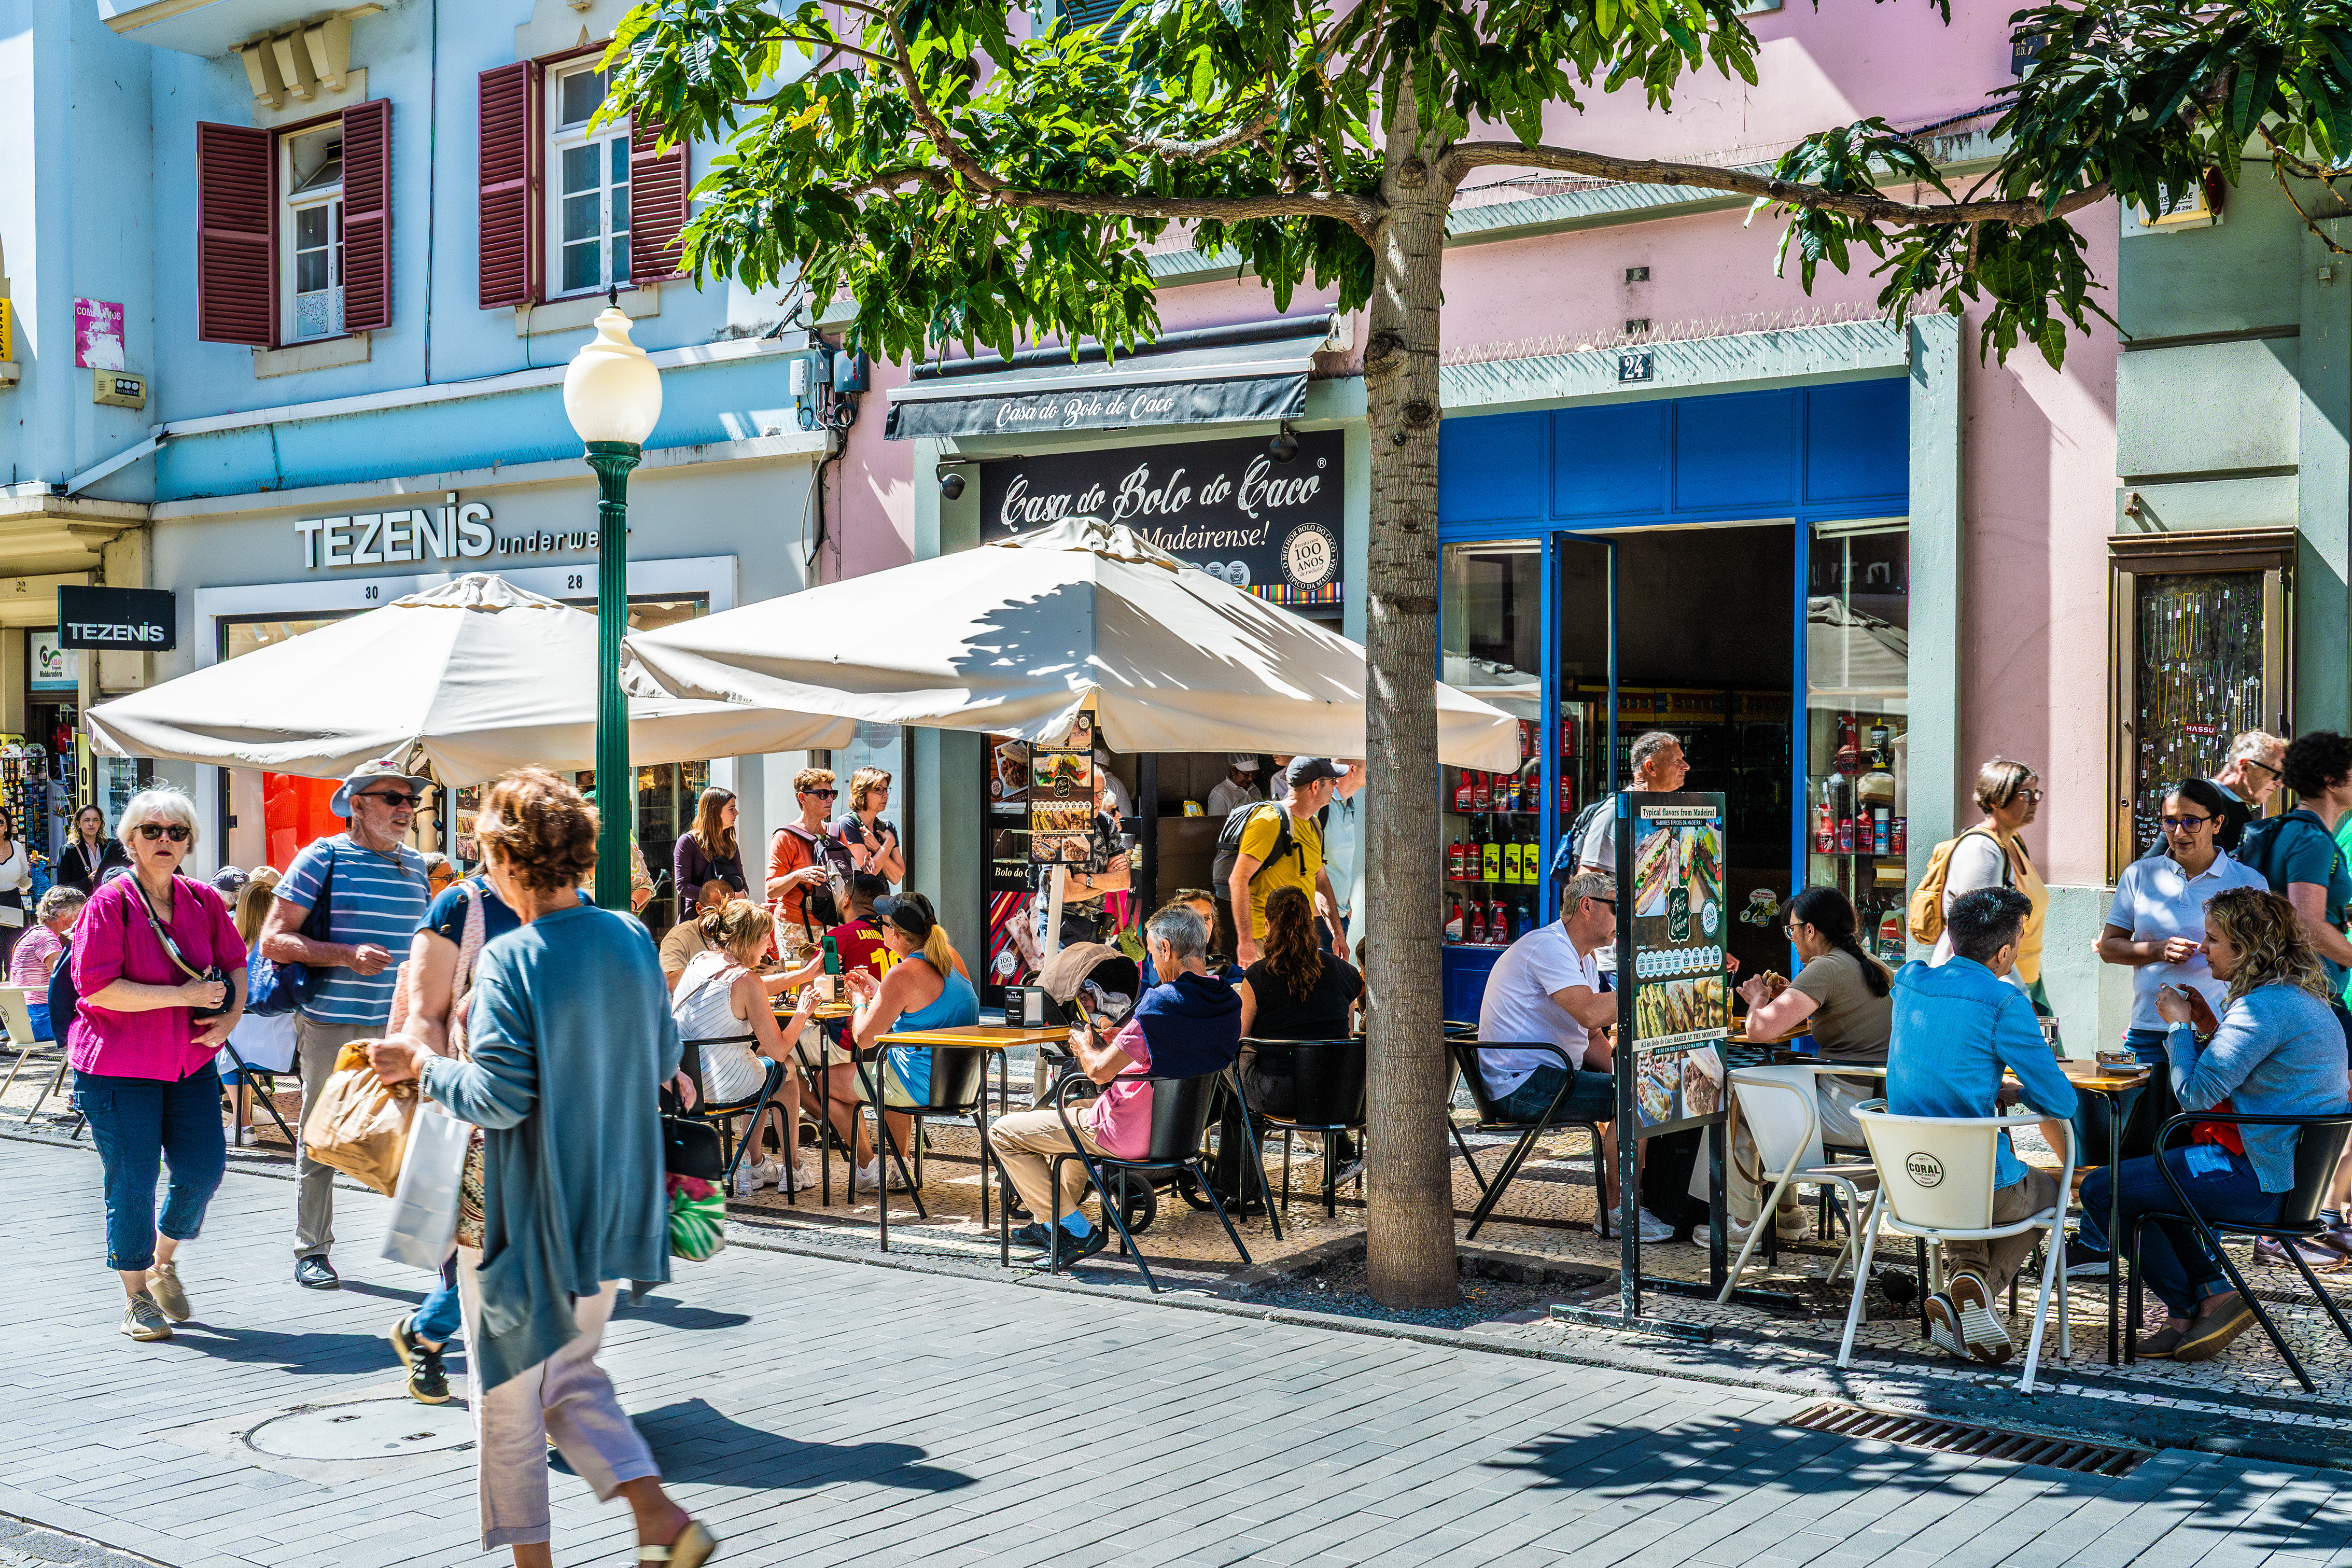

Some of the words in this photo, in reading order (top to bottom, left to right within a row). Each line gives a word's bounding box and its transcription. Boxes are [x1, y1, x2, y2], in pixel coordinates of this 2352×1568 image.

[1624, 355, 1644, 380] 24
[996, 402, 1037, 427] Casa
[1039, 399, 1059, 419] do
[1063, 396, 1103, 427] Bolo
[1105, 394, 1127, 415] do
[1130, 394, 1174, 419] Caco
[1001, 473, 1072, 533] Casa
[1077, 482, 1106, 513] do
[1108, 463, 1191, 525] Bolo
[1200, 473, 1231, 506] do
[294, 492, 494, 568] TEZENIS
[498, 529, 631, 554] underwe
[1141, 521, 1269, 551] Madeirense!
[1282, 530, 1298, 561] MELHOR
[1297, 524, 1315, 534] BOLO
[1316, 526, 1326, 535] DO
[1325, 534, 1336, 553] CACO
[1294, 540, 1309, 549] Receita
[1294, 542, 1321, 561] 100
[1297, 555, 1324, 572] ANOS
[1306, 565, 1323, 575] tradição!
[1286, 571, 1306, 589] TÍPICO
[1317, 558, 1336, 587] MADEIRA
[16, 581, 26, 593] 32
[568, 575, 583, 589] 28
[365, 585, 379, 599] 30
[67, 621, 165, 642] TEZENIS
[1643, 808, 1661, 818] Typical
[995, 867, 1012, 877] Bolo
[1014, 868, 1023, 877] do
[1671, 896, 1686, 920] Bolo
[1704, 908, 1714, 920] 100
[1671, 917, 1687, 936] Caco
[1706, 916, 1715, 927] ANOS
[856, 929, 884, 941] LAMINE
[1701, 1030, 1720, 1039] MOMENT!
[1909, 1163, 1940, 1174] CORAL
